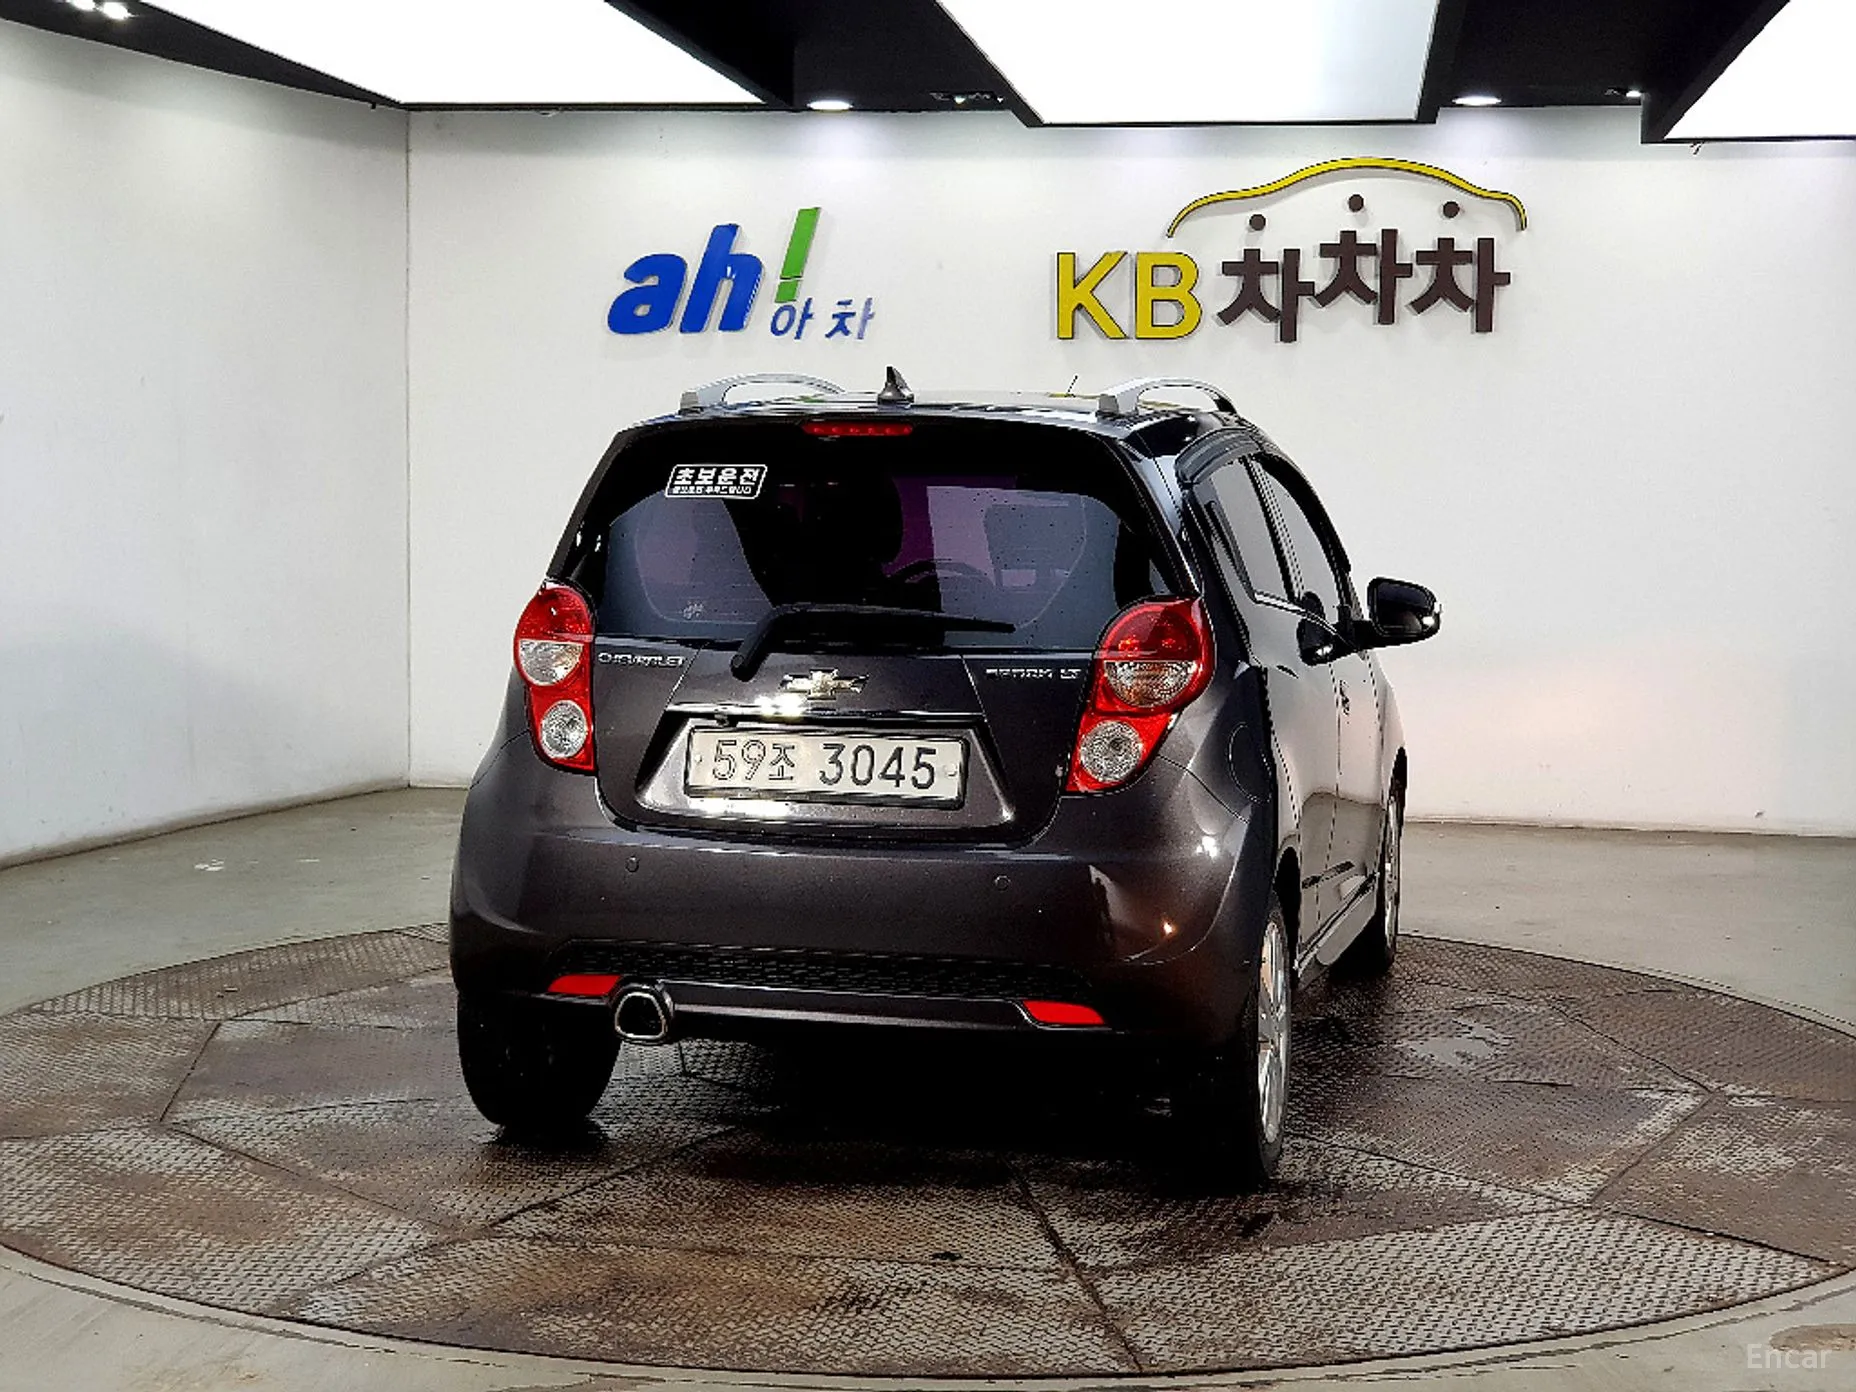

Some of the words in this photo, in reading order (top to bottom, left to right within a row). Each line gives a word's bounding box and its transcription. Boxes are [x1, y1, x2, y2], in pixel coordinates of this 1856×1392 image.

[607, 207, 821, 334] ah!
[1057, 251, 1203, 340] KB
[1216, 194, 1511, 343] 차차차
[673, 467, 760, 485] 초보운전
[712, 739, 796, 781] 59조
[818, 742, 938, 791] 3045
